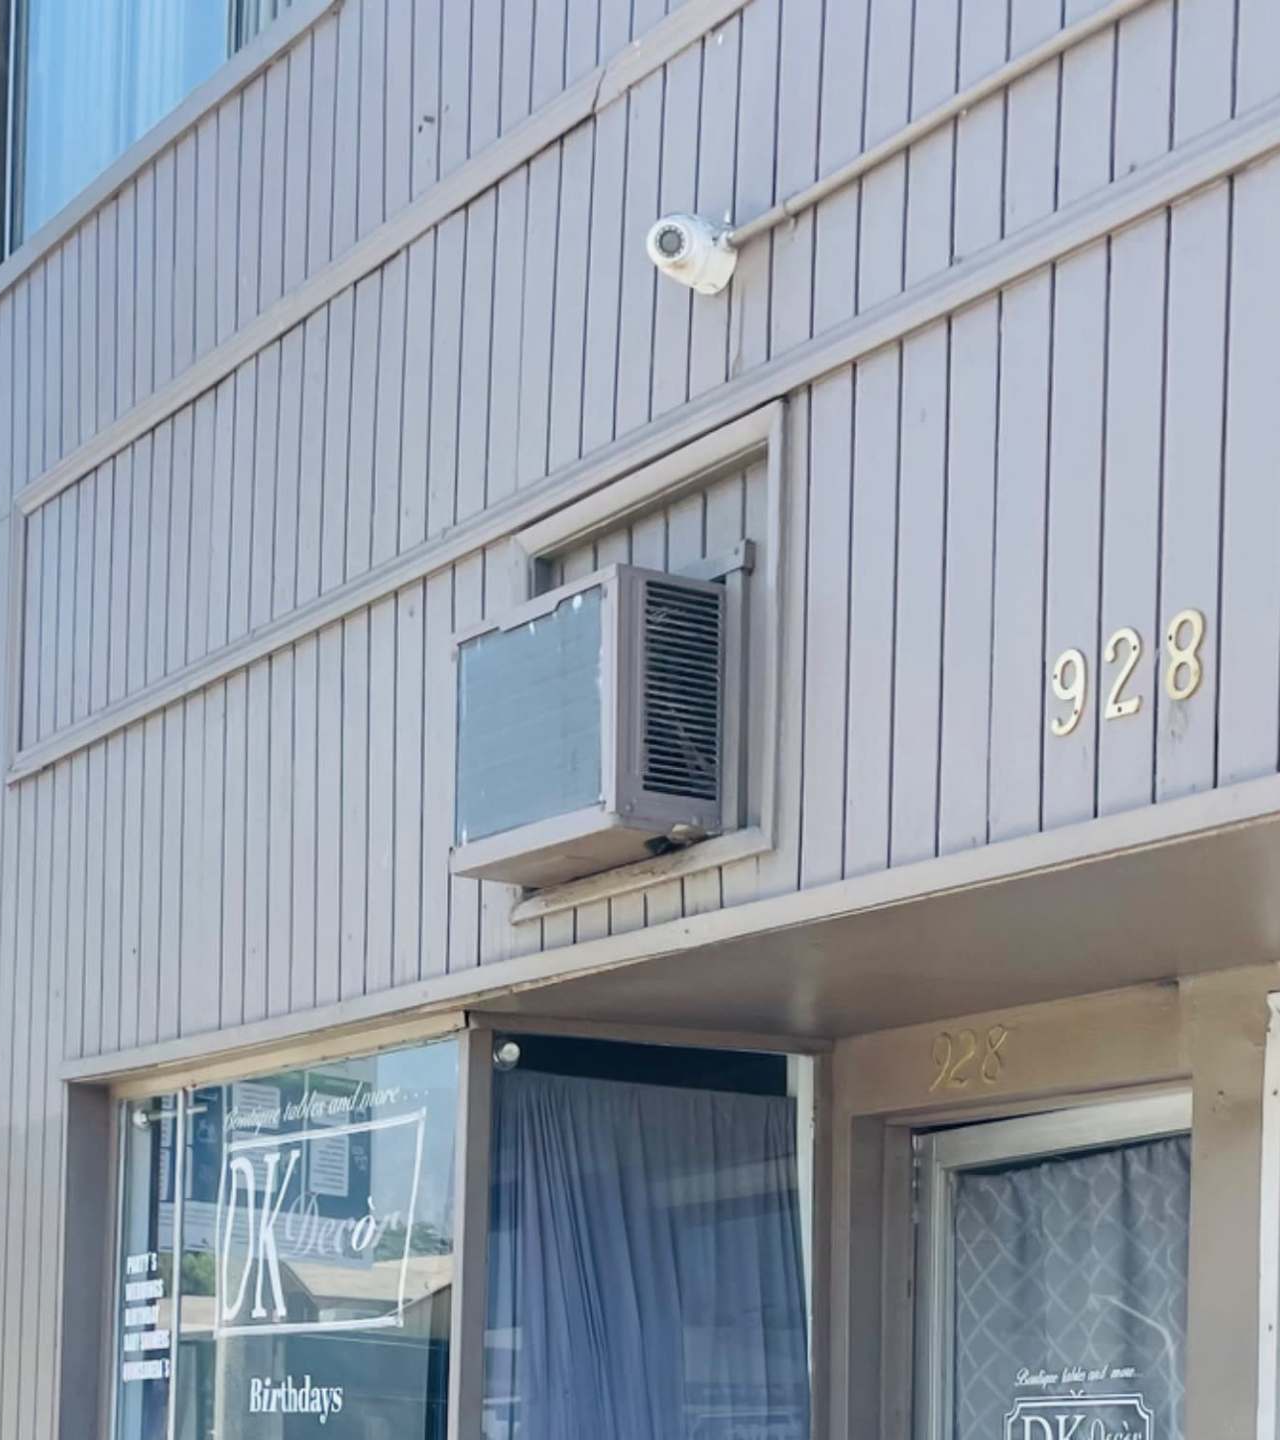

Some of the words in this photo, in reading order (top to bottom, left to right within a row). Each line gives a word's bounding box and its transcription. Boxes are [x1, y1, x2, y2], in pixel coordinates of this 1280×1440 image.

[1050, 608, 1206, 737] 928
[929, 1023, 1014, 1093] 928
[283, 1088, 325, 1122] tables
[327, 1080, 363, 1116] and
[222, 1148, 301, 1323] DK
[249, 1375, 344, 1420] Birthdays
